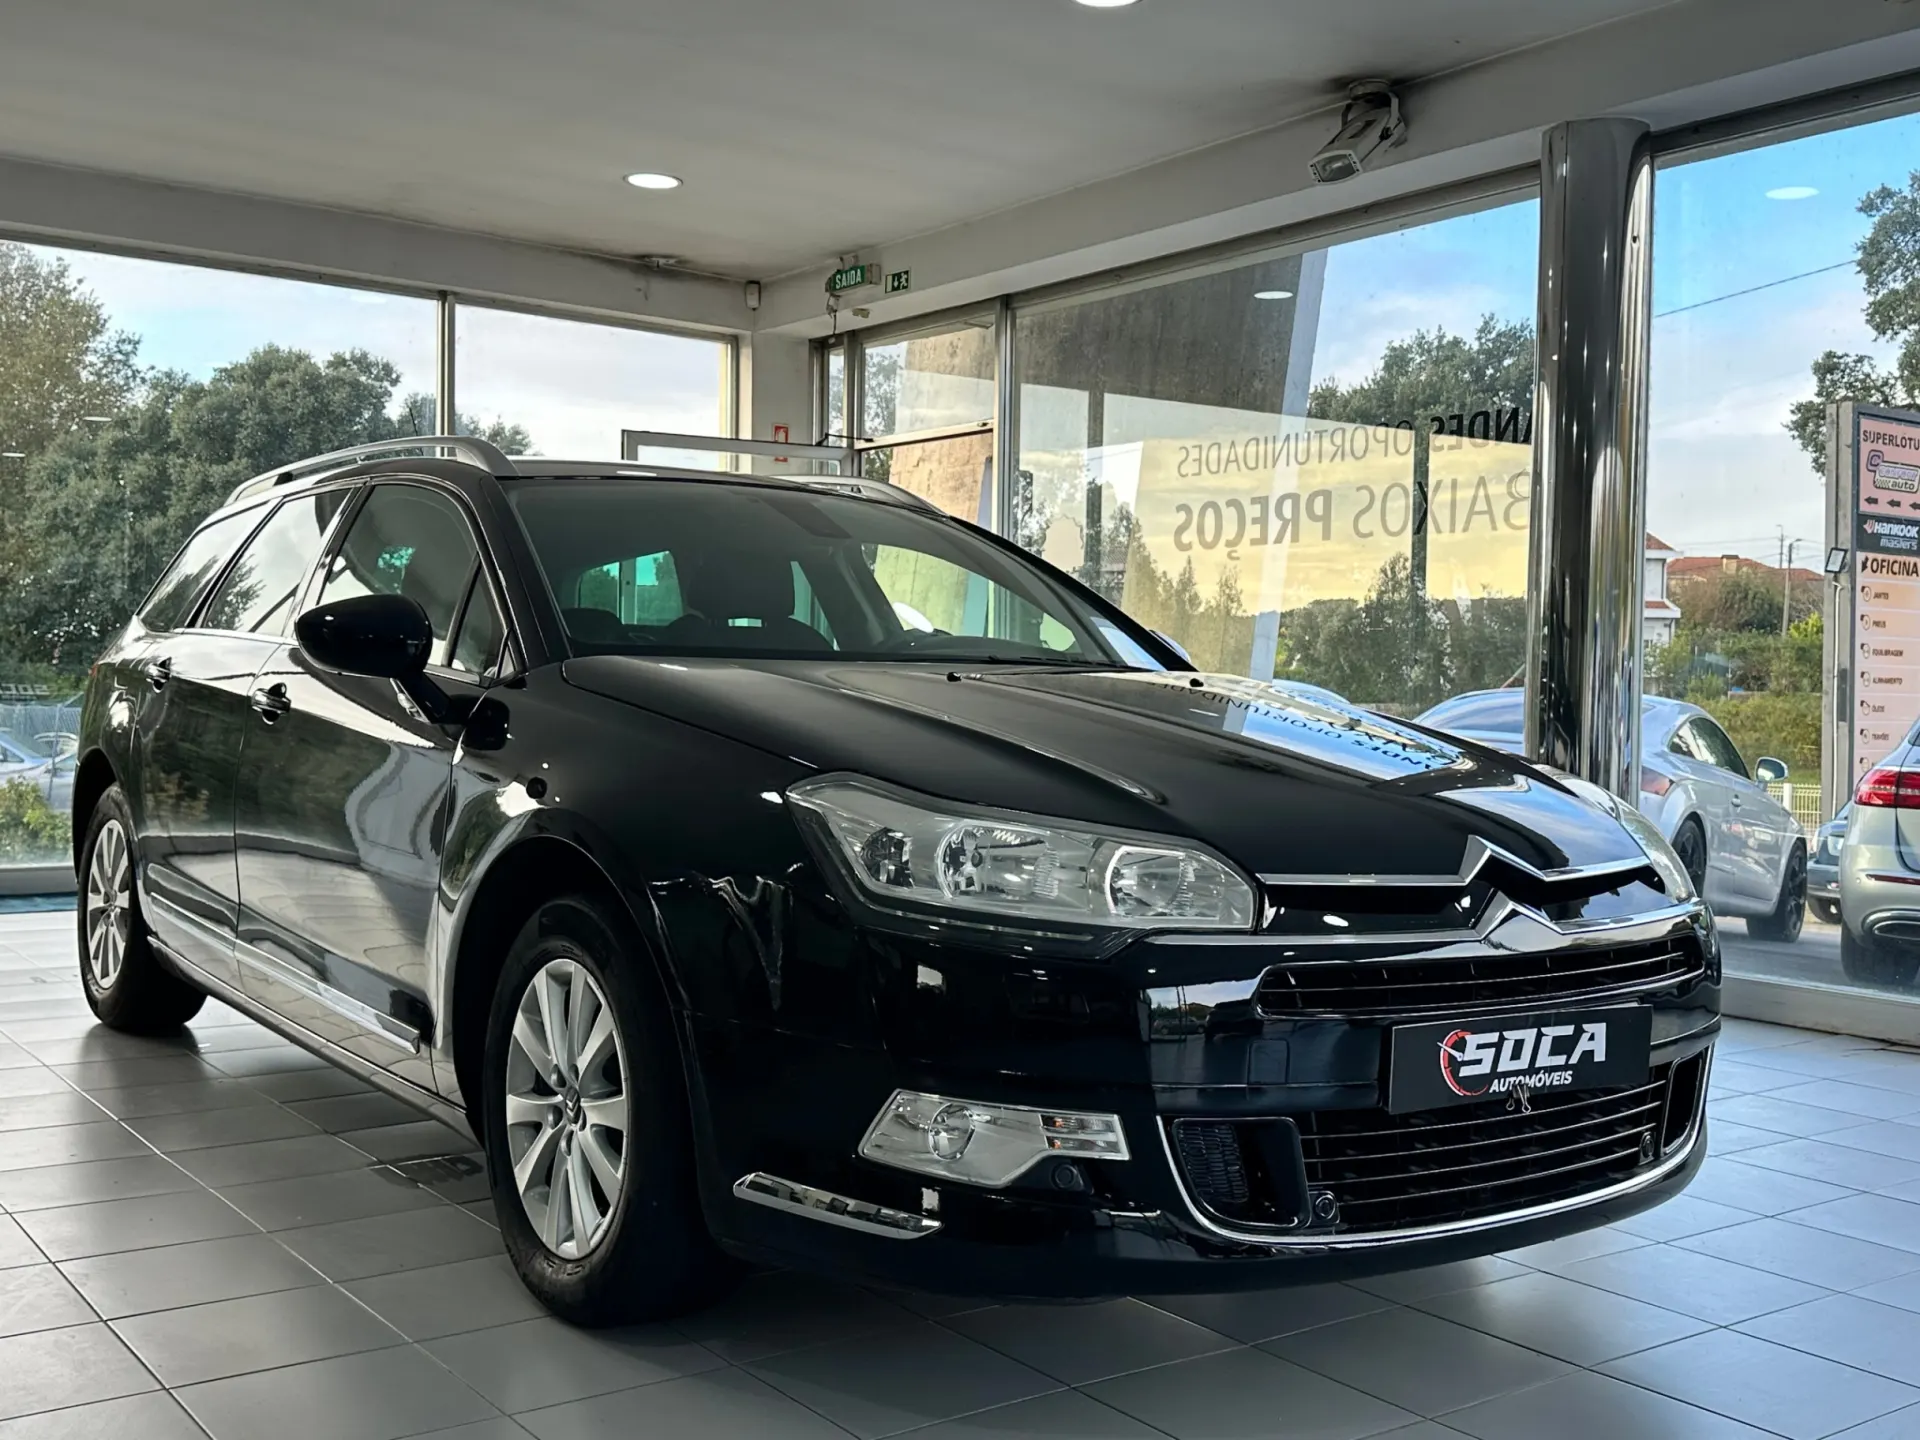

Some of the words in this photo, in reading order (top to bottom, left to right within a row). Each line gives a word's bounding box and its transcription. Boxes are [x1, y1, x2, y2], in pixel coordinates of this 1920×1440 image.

[1891, 481, 1915, 491] auto
[1870, 557, 1919, 577] OFICINA
[1459, 1022, 1607, 1077] SOCA
[1489, 1070, 1573, 1093] AUTOMÓVEIS
